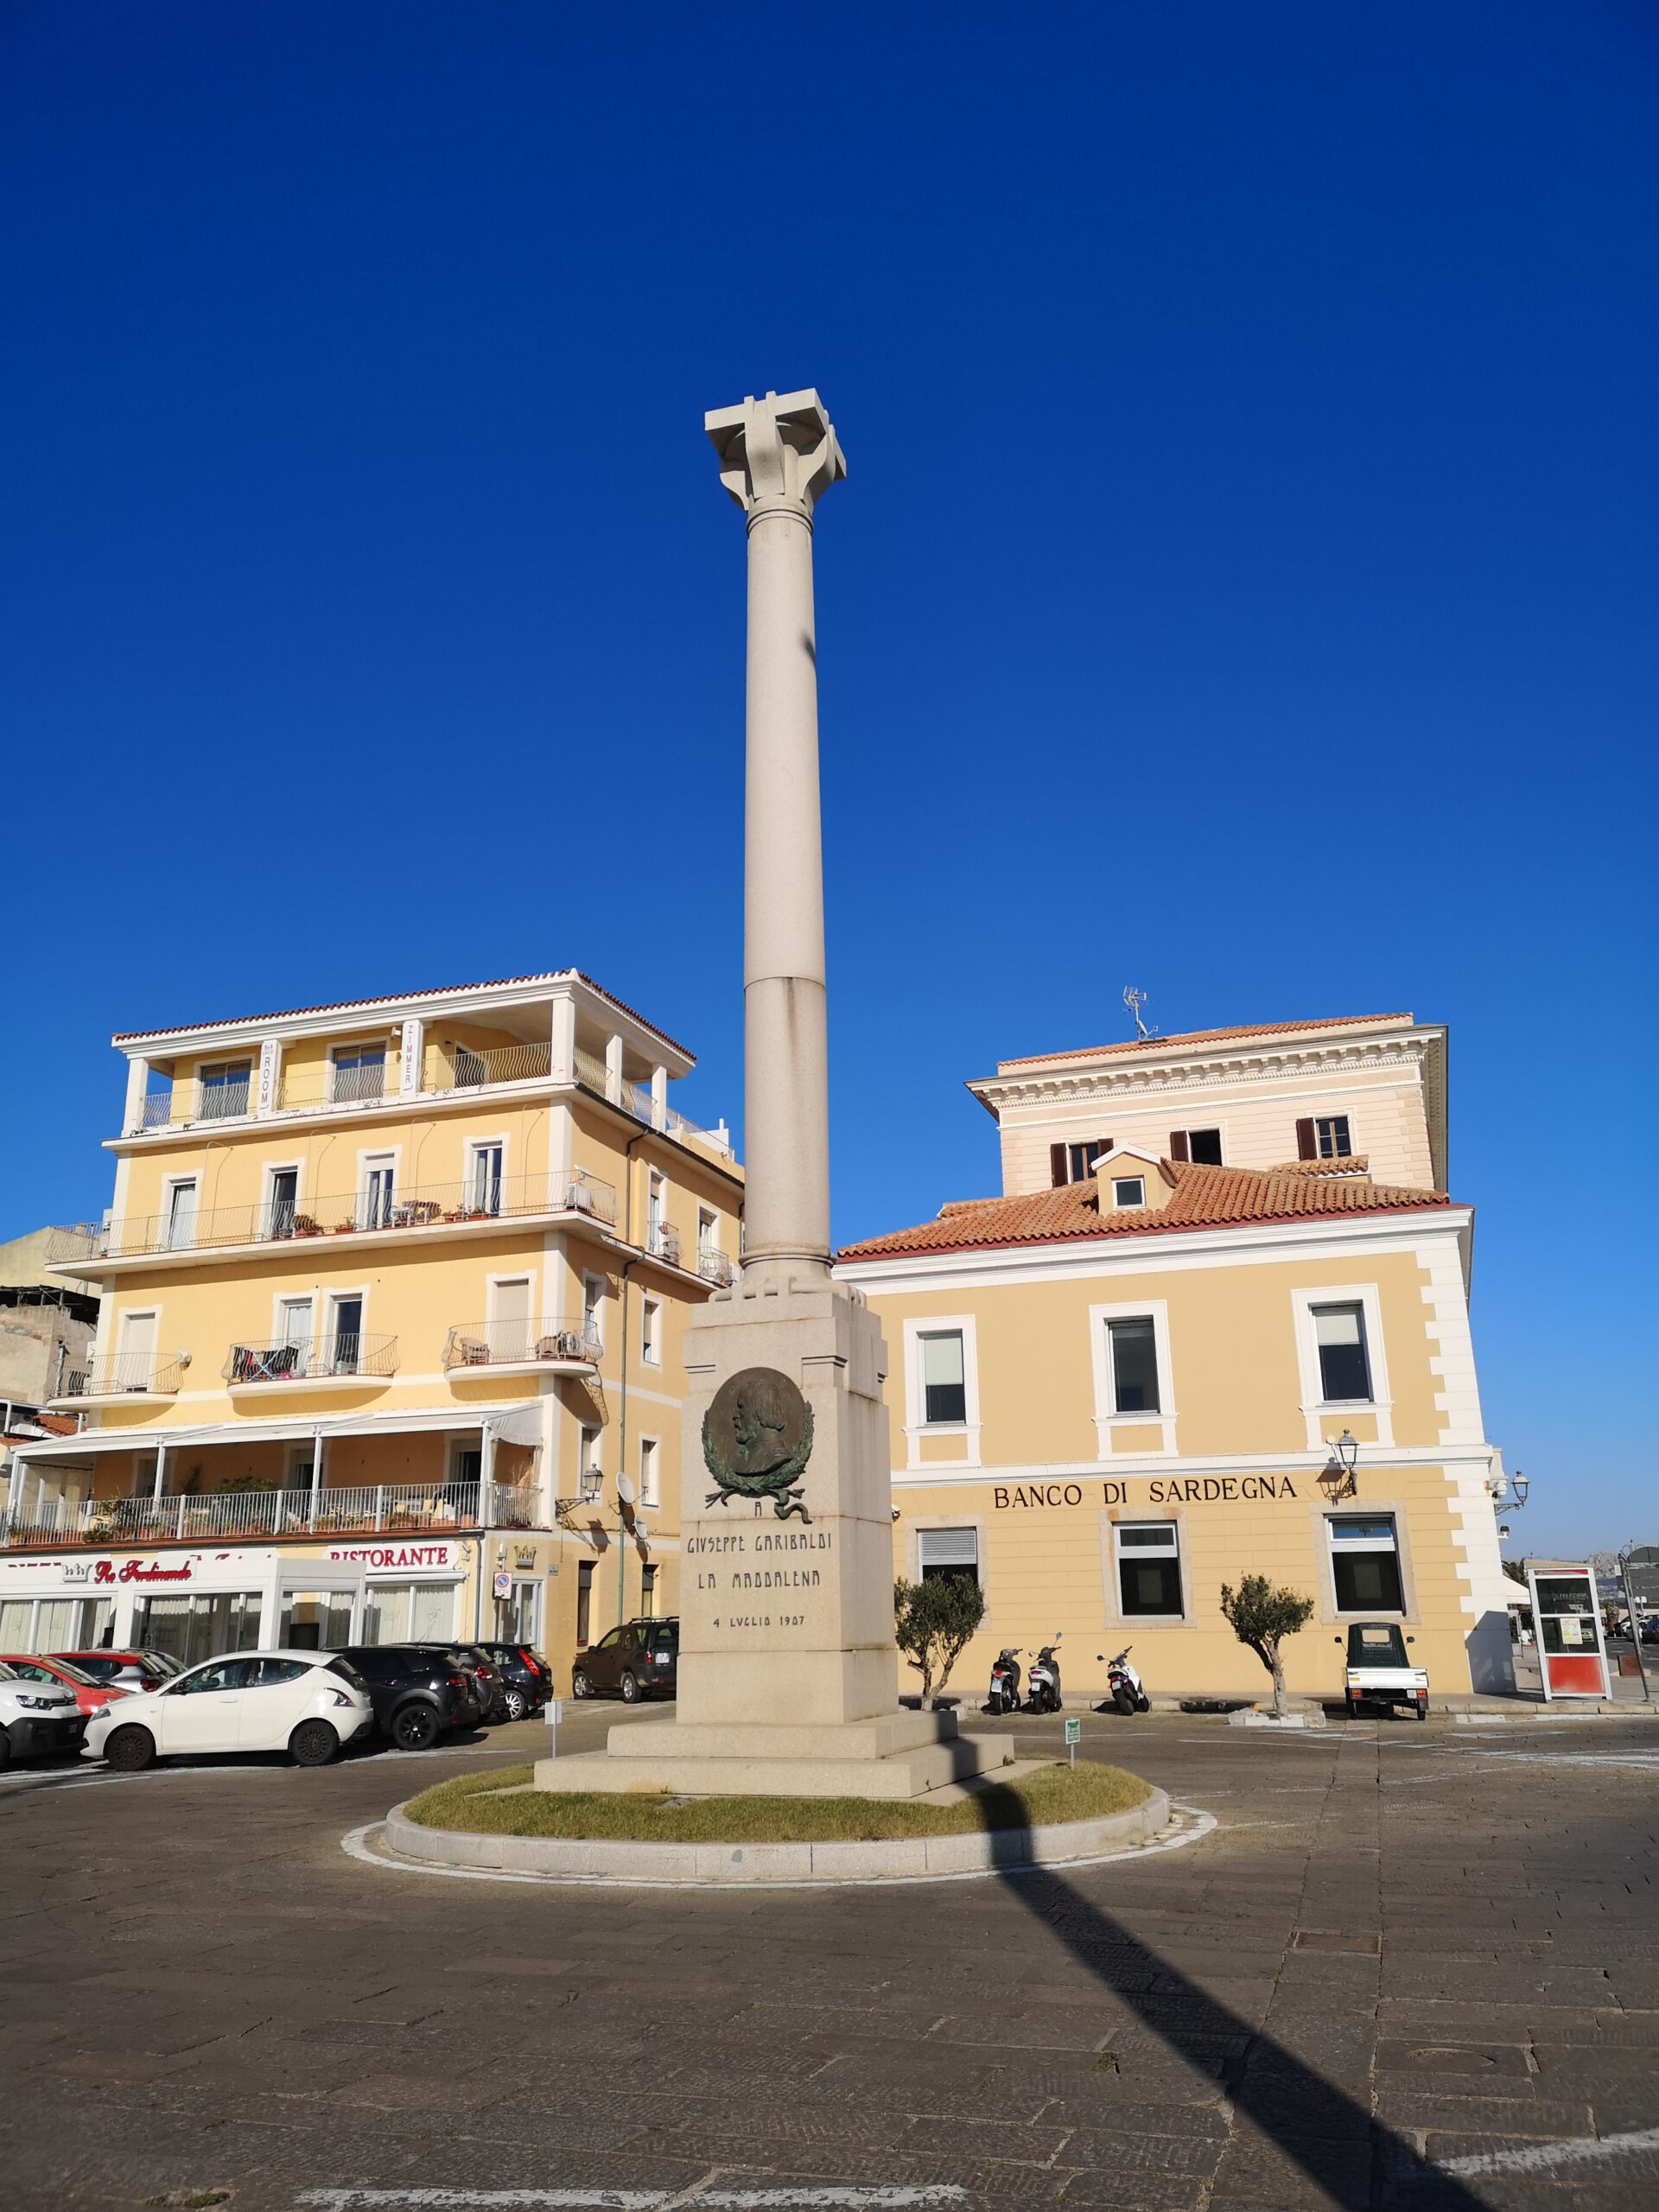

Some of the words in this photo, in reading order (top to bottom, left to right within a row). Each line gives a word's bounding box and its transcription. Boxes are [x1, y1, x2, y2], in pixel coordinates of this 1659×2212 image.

[404, 1025, 413, 1084] ZIMMER
[261, 1056, 270, 1104] ROOM
[994, 1484, 1082, 1509] BANCO
[1103, 1482, 1128, 1504] DI
[1149, 1476, 1298, 1503] SARDEGNA
[754, 1501, 762, 1516] A
[755, 1533, 831, 1551] GARIBALDI
[94, 1560, 116, 1584] Re
[698, 1573, 716, 1589] LA
[732, 1570, 821, 1588] MADDALENA
[713, 1618, 720, 1628] 4
[779, 1616, 805, 1626] 1907
